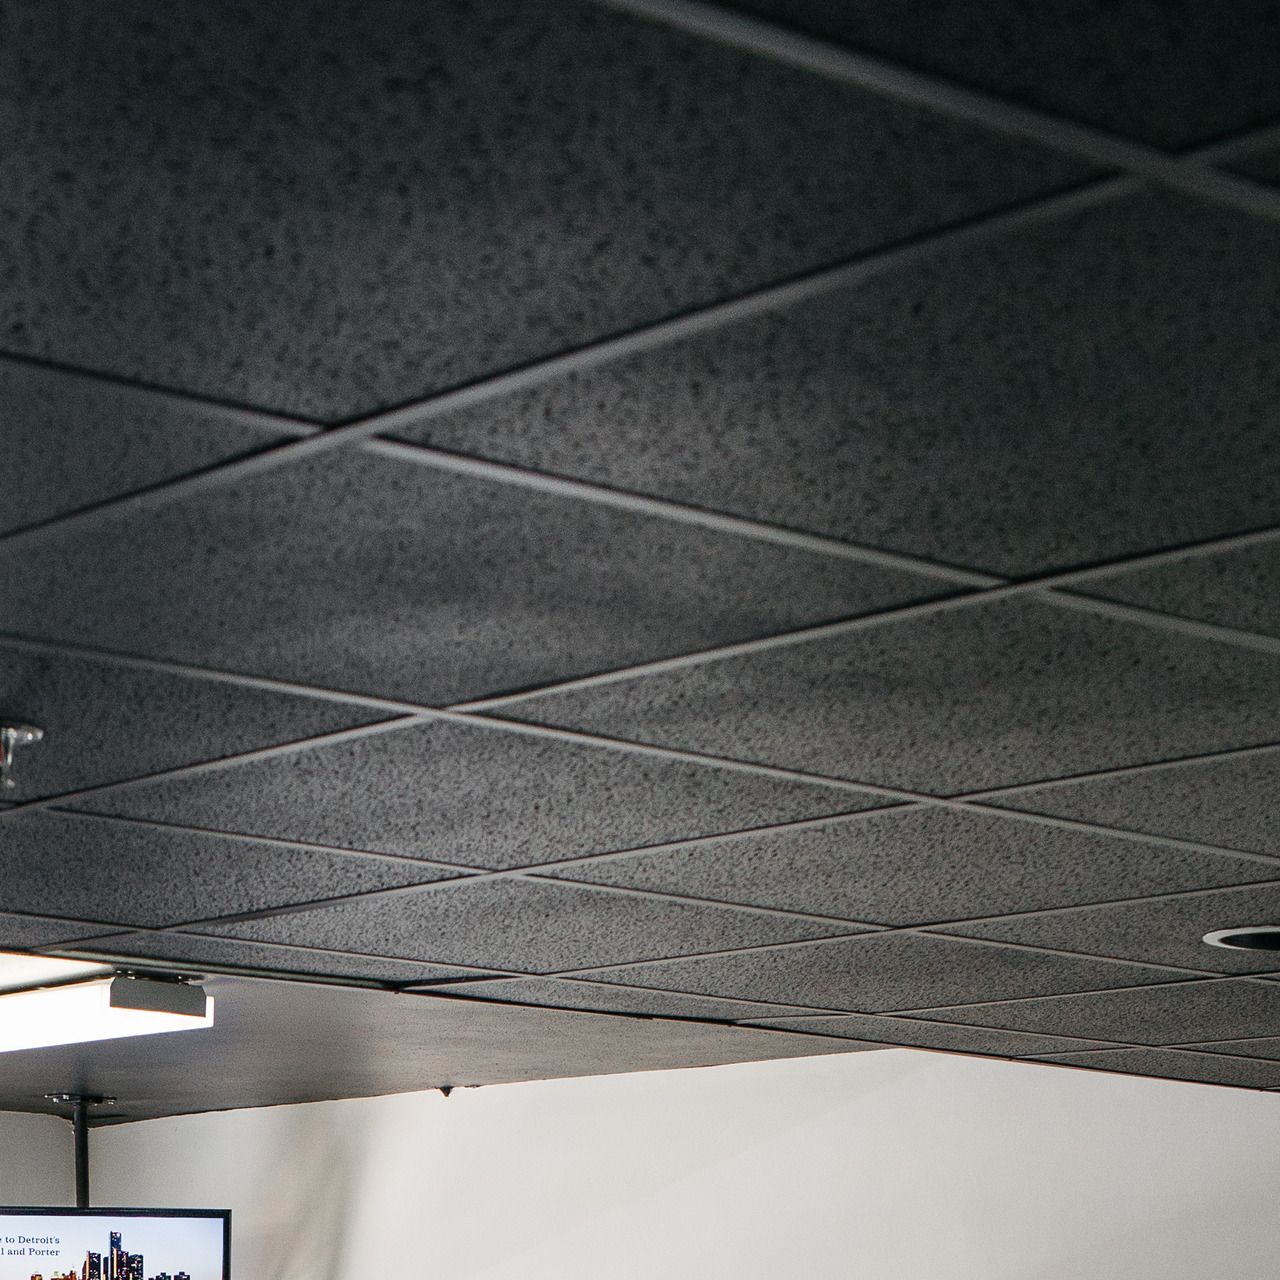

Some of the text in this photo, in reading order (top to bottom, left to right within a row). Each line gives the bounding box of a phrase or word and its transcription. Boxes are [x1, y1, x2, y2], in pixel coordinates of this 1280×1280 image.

[5, 1236, 15, 1244] to
[18, 1236, 60, 1244] Detroit's
[7, 1248, 25, 1256] and
[28, 1248, 60, 1257] Porter
